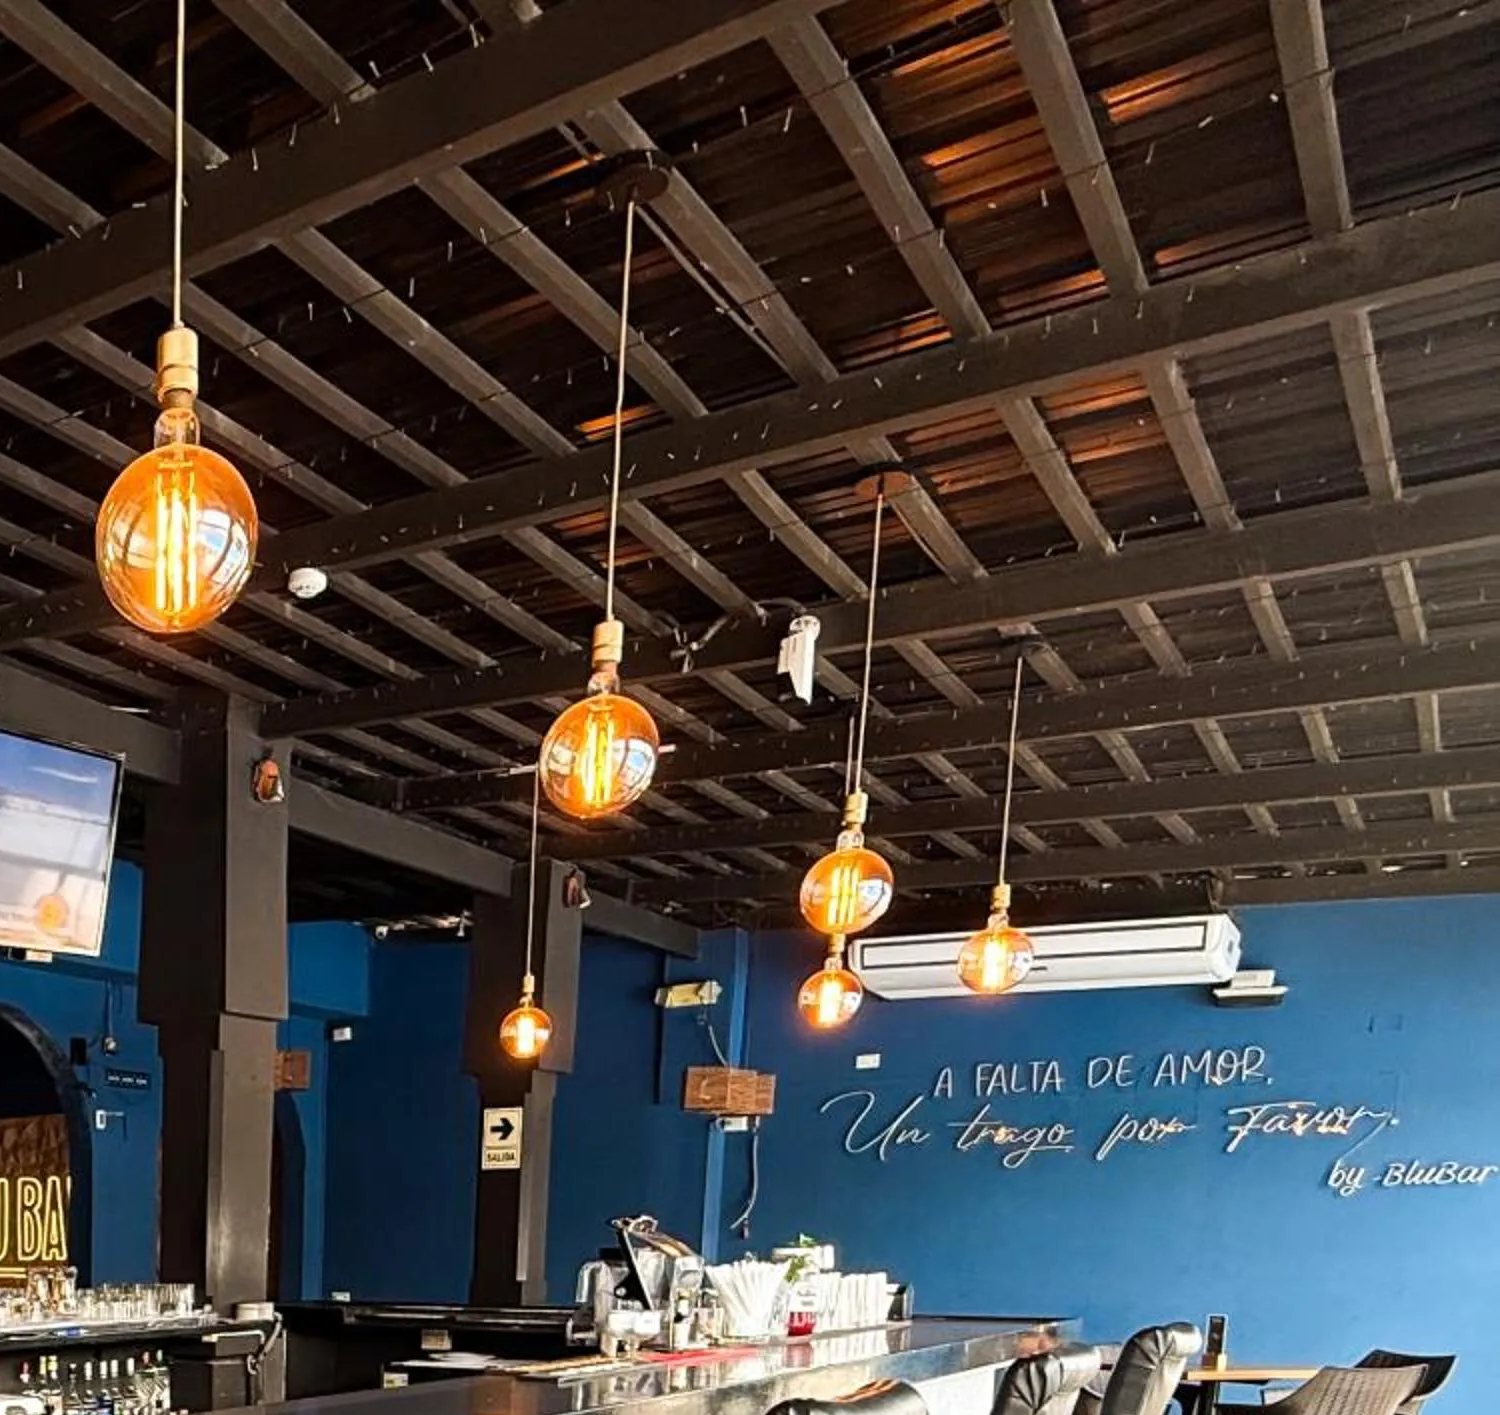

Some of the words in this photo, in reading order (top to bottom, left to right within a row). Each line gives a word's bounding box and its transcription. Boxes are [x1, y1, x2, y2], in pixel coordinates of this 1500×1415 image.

[932, 1066, 953, 1099] A
[975, 1060, 1065, 1098] FALTA
[1087, 1054, 1135, 1089] DE
[1153, 1046, 1275, 1088] AMOR.
[819, 1090, 931, 1162] Un
[946, 1103, 1076, 1169] trago
[1095, 1113, 1197, 1161] por
[1327, 1158, 1367, 1197] by
[16, 1175, 72, 1261] BA
